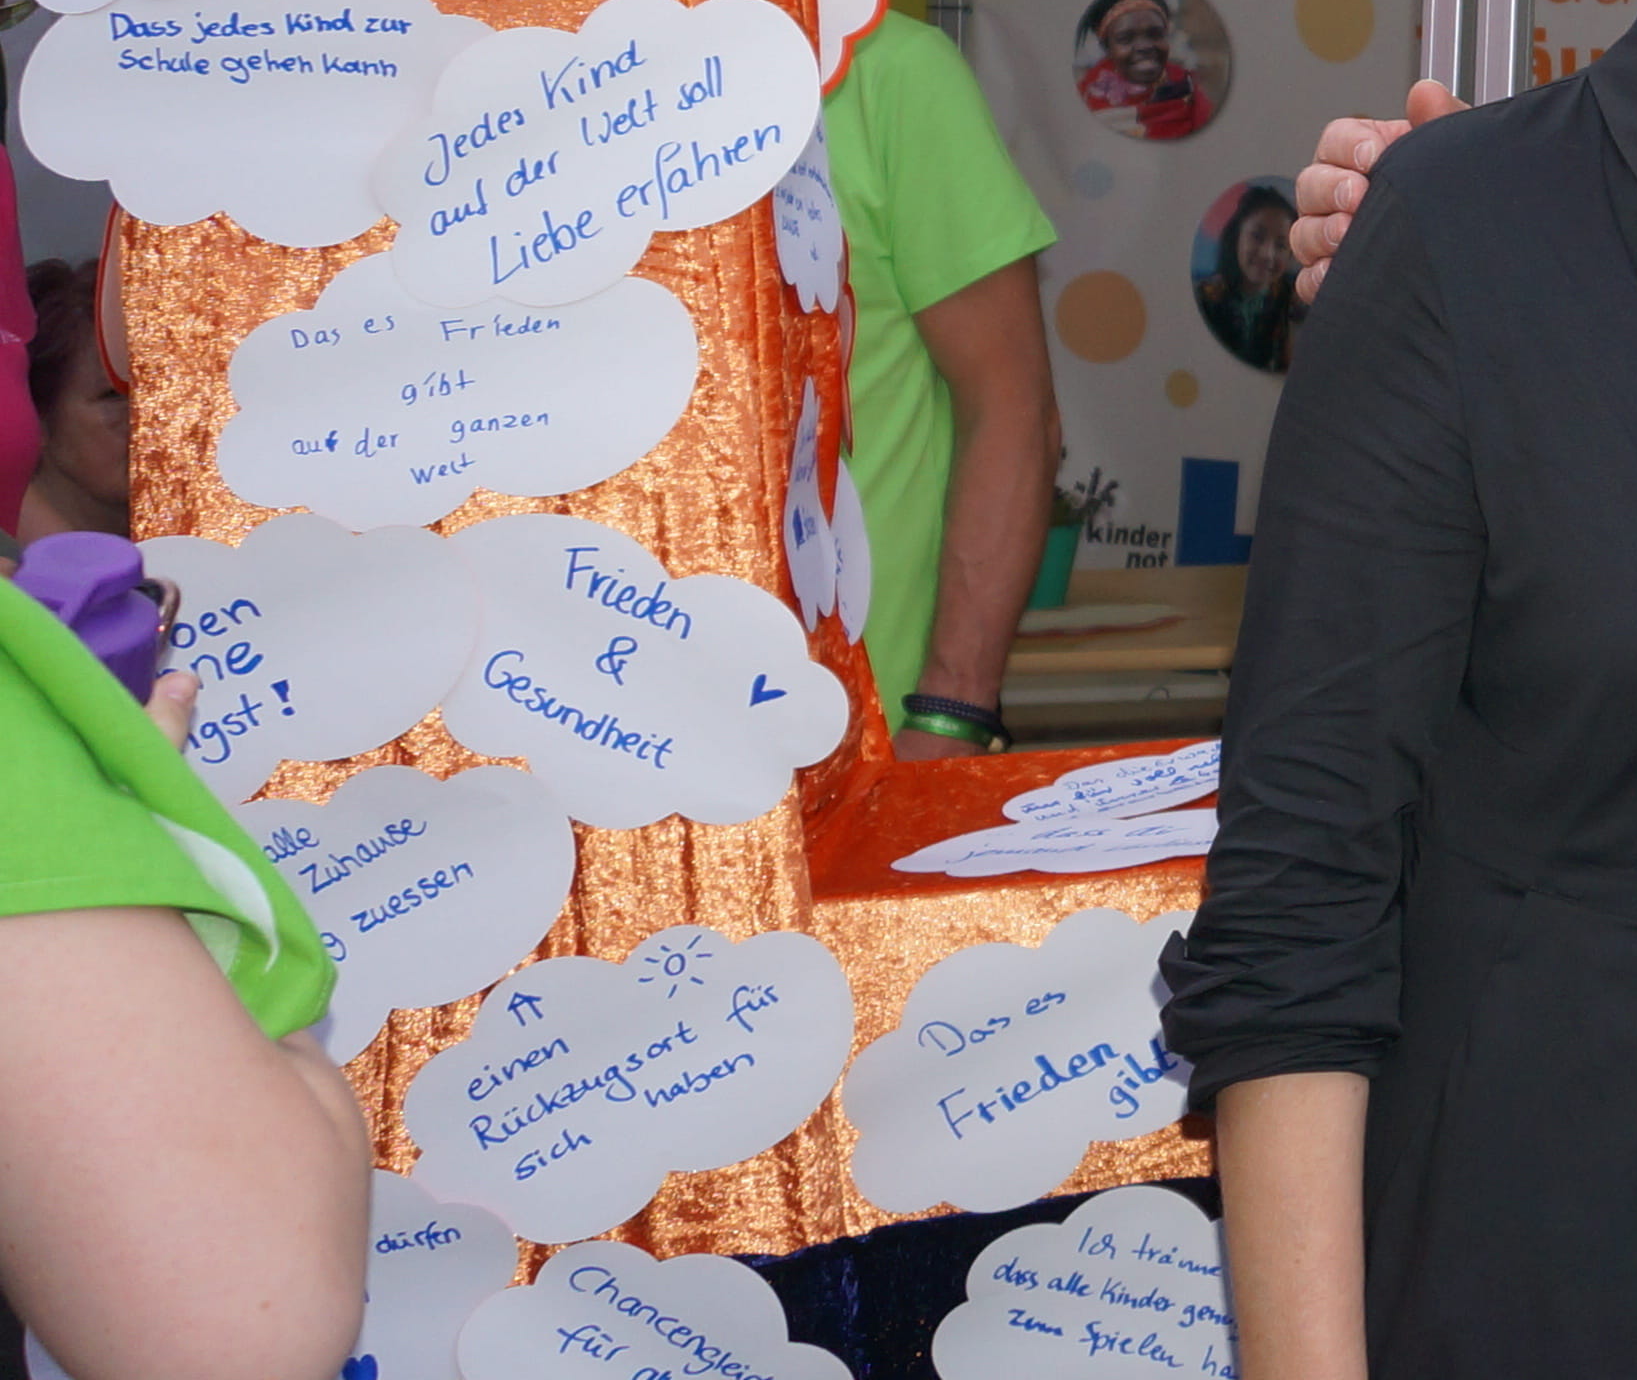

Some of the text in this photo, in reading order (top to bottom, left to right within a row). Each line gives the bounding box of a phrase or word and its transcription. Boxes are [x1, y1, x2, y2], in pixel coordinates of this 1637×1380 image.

[110, 15, 183, 40] Dass
[191, 11, 276, 42] jedes
[364, 15, 413, 37] zur
[118, 51, 212, 78] Schule
[219, 53, 314, 82] gehen
[422, 40, 646, 188] Jedes Kind
[428, 55, 724, 237] auf der Welt soll
[488, 208, 594, 286] Liebe
[614, 122, 782, 222] erfahren
[292, 313, 563, 350] Das es Frieden
[400, 372, 477, 405] gibt
[291, 408, 551, 456] auf der ganzen
[1086, 521, 1172, 549] kinder
[1126, 551, 1168, 568] not
[566, 546, 693, 641] Frieden
[596, 635, 639, 686] &
[484, 650, 673, 771] Gesundheit
[299, 817, 428, 894] Zuhause
[917, 992, 1067, 1060] Das es
[466, 1038, 570, 1103] einen
[468, 982, 781, 1154] Rückzugsort für
[937, 1042, 1120, 1142] Frieden
[515, 1050, 757, 1181] sich haben
[376, 1222, 461, 1255] dürfen
[1077, 1226, 1117, 1260] Ich
[992, 1257, 1238, 1328] dass alle Kinder genu
[557, 1324, 631, 1361] für
[1079, 1320, 1184, 1368] Spielen
